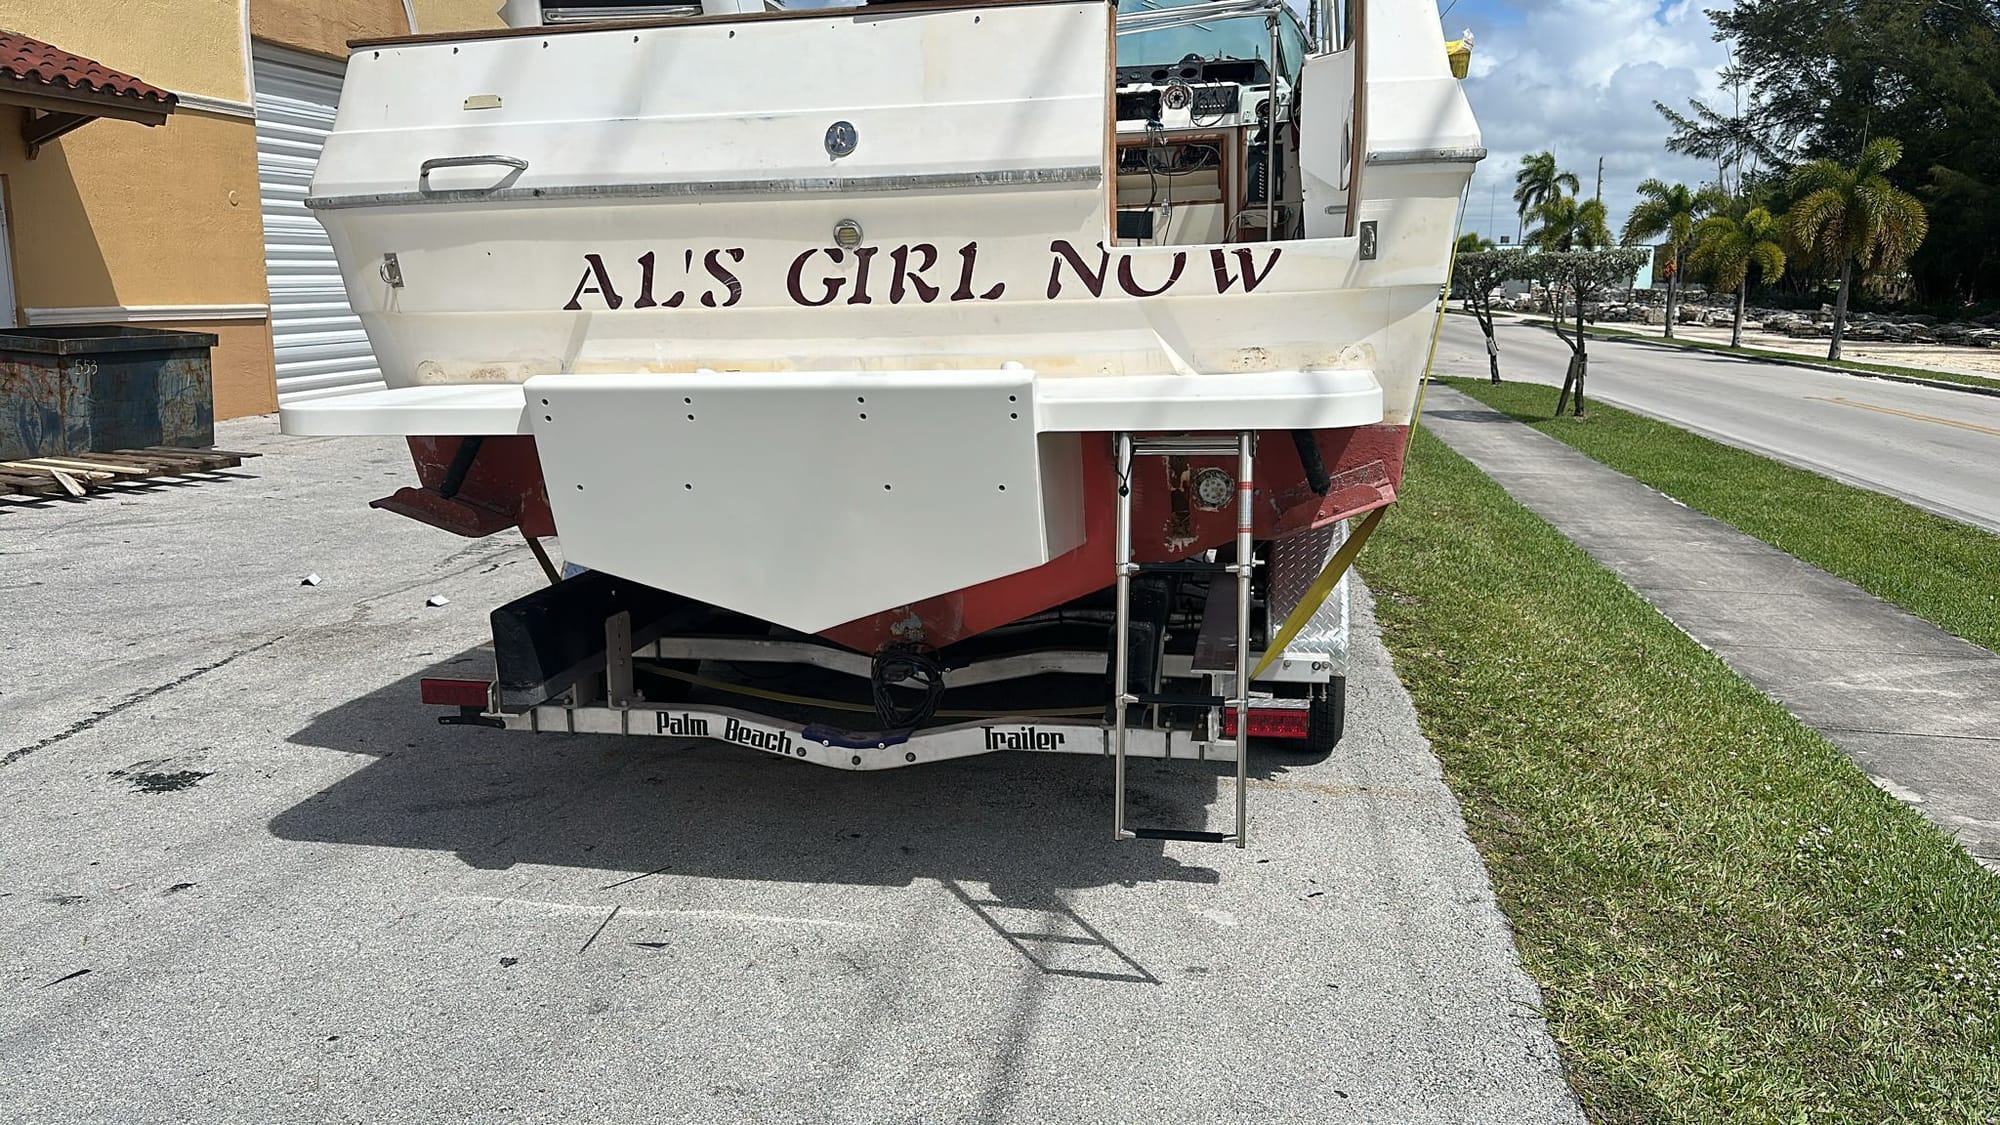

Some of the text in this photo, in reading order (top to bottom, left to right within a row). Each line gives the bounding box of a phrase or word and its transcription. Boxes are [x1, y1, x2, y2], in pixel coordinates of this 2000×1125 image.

[563, 240, 1281, 310] AL'S GIRL NOW
[75, 359, 98, 375] 553
[656, 711, 1064, 755] Palm Beach Trailer
